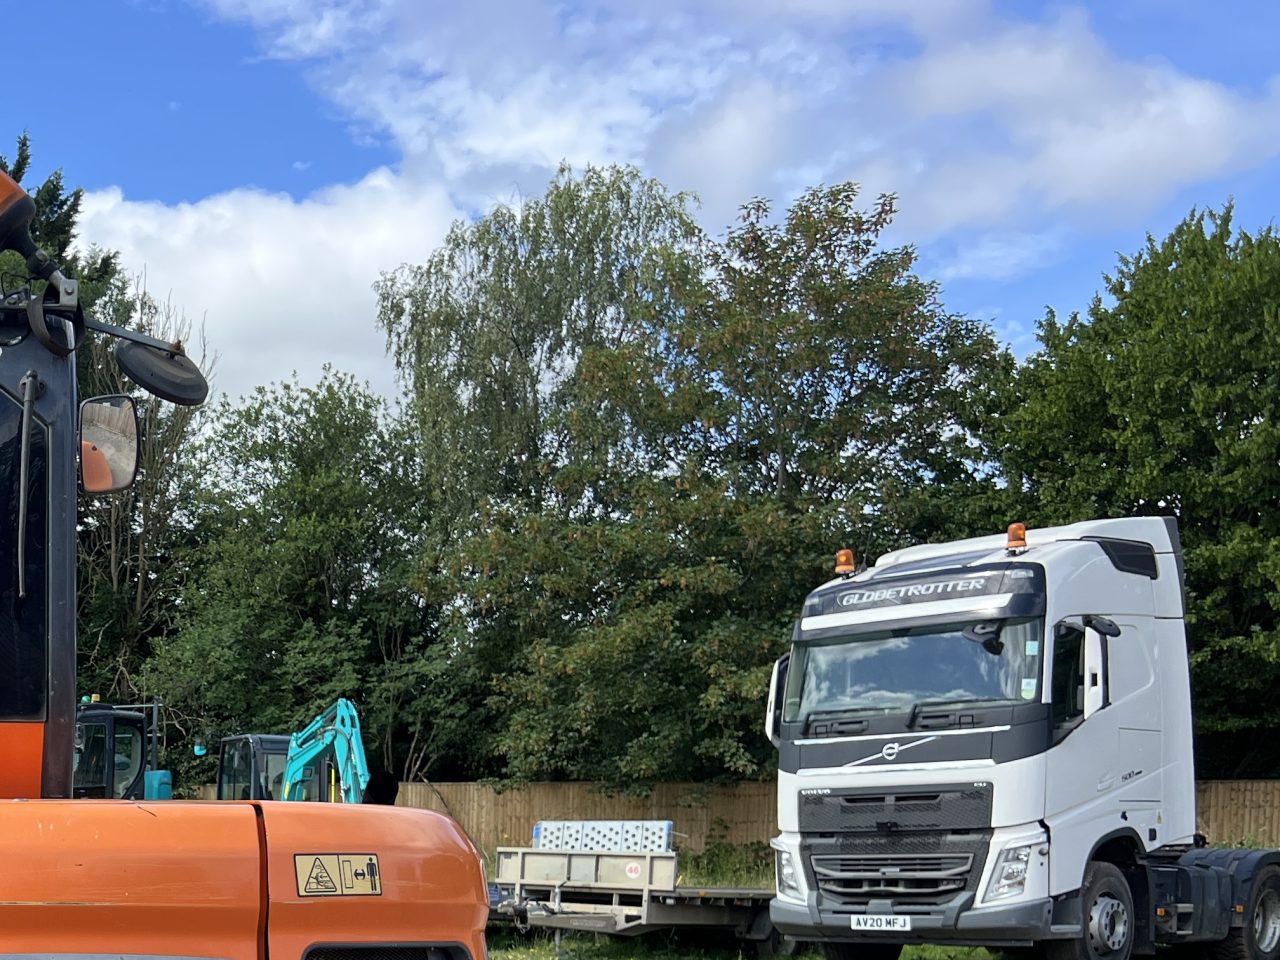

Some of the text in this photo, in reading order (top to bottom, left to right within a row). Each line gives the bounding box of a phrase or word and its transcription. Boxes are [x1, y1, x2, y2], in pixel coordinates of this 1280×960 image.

[842, 578, 985, 606] GLOBETROTTER
[627, 864, 639, 874] 46
[856, 918, 906, 928] AV20 MFJ
